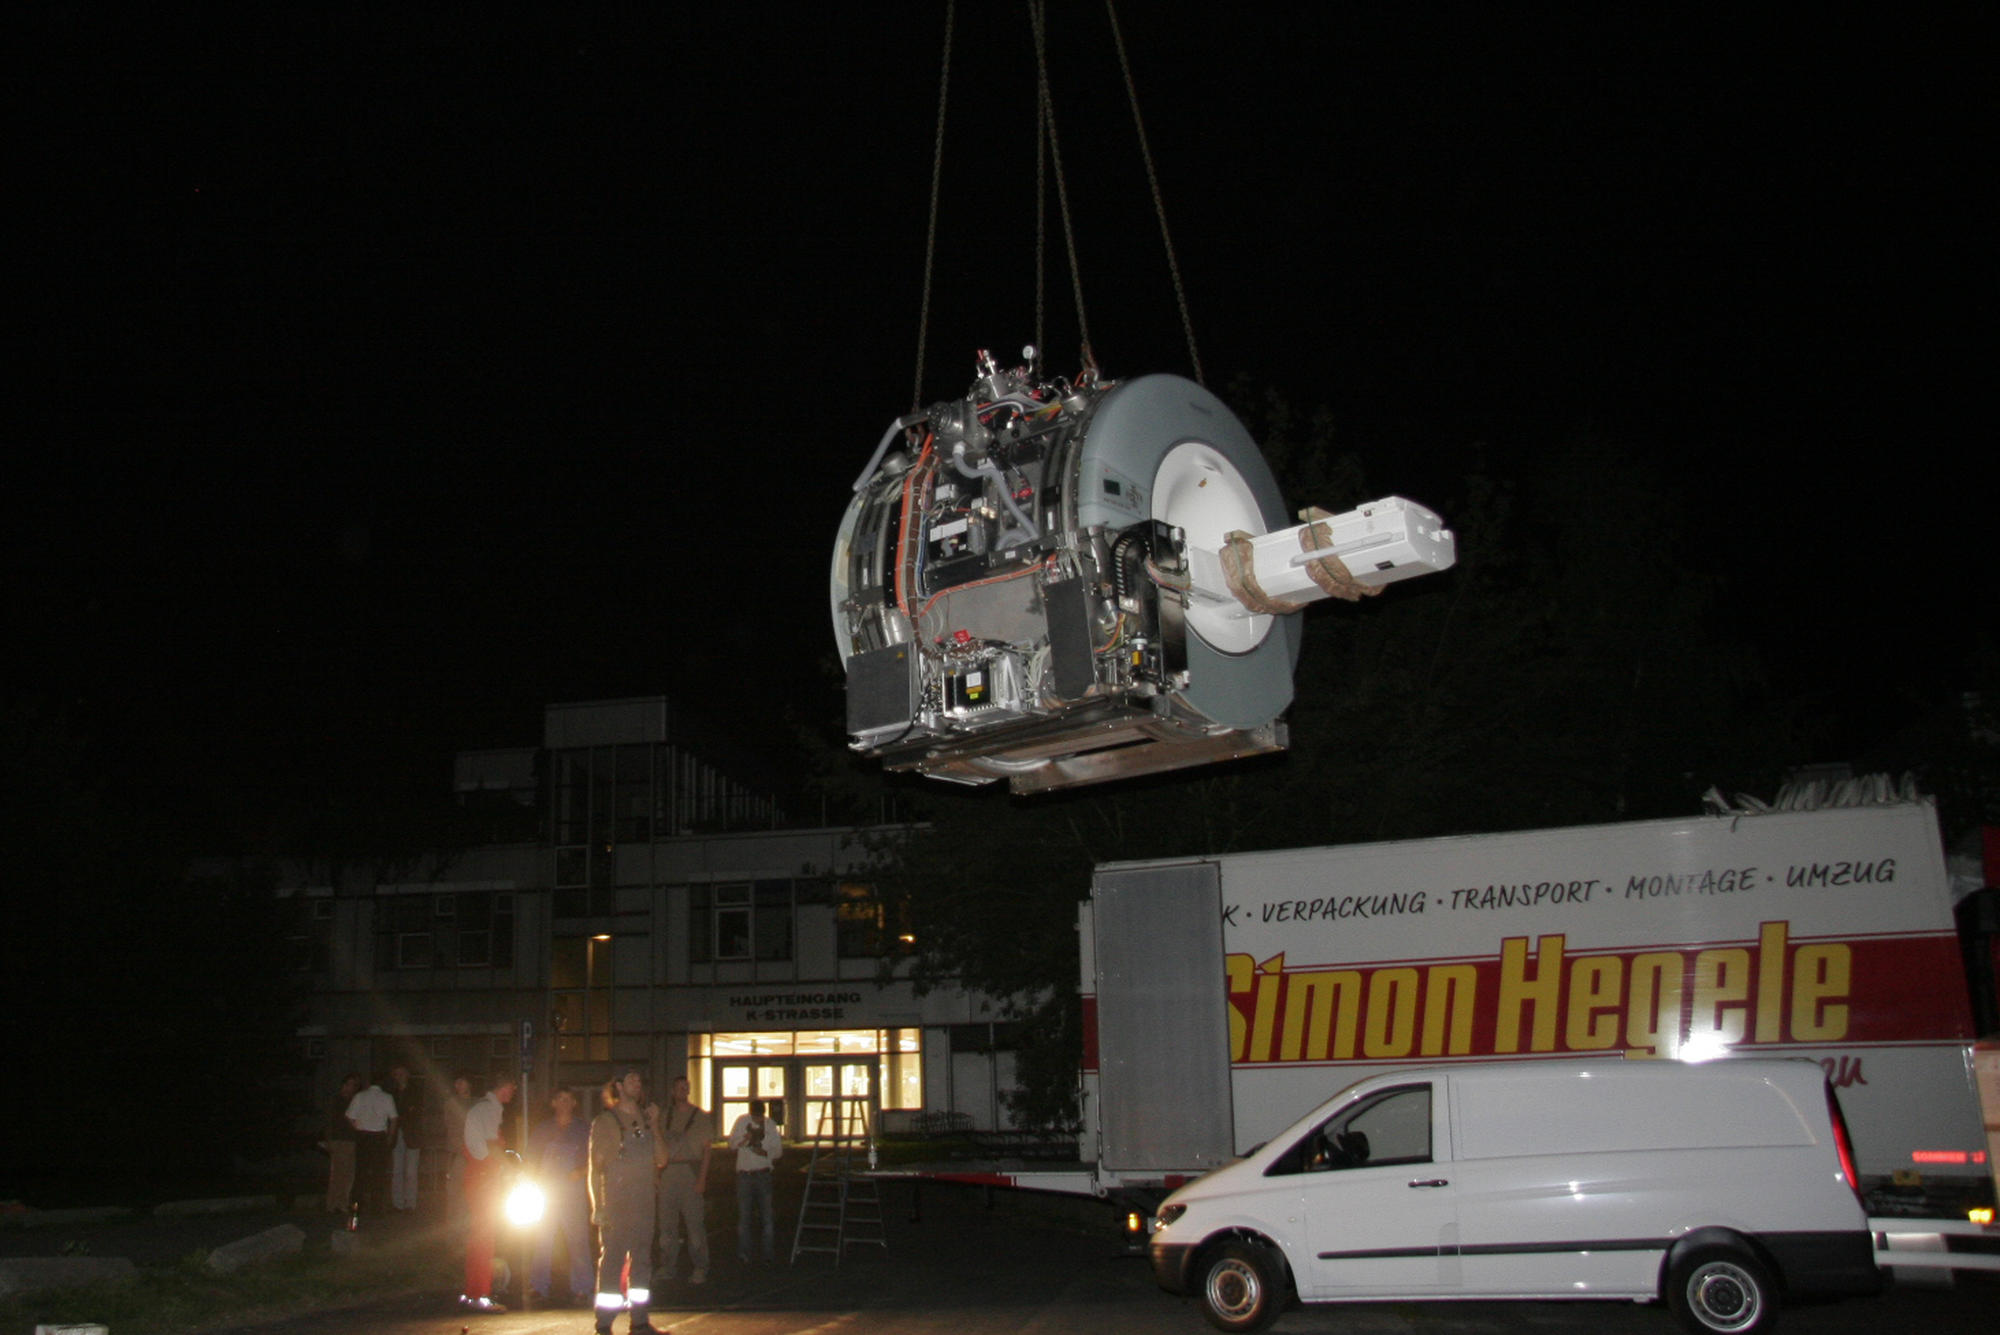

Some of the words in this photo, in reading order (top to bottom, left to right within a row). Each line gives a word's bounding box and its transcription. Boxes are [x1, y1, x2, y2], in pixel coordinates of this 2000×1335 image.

[1262, 891, 1427, 923] VERPACKUNG
[1450, 879, 1600, 911] TRANSPORT
[1625, 867, 1758, 900] MONTAGE
[1786, 858, 1897, 889] UMZUG
[729, 991, 862, 1007] HAUPTEINGANG
[1494, 920, 1853, 1061] Hegele
[746, 1007, 845, 1021] K-STRASSE
